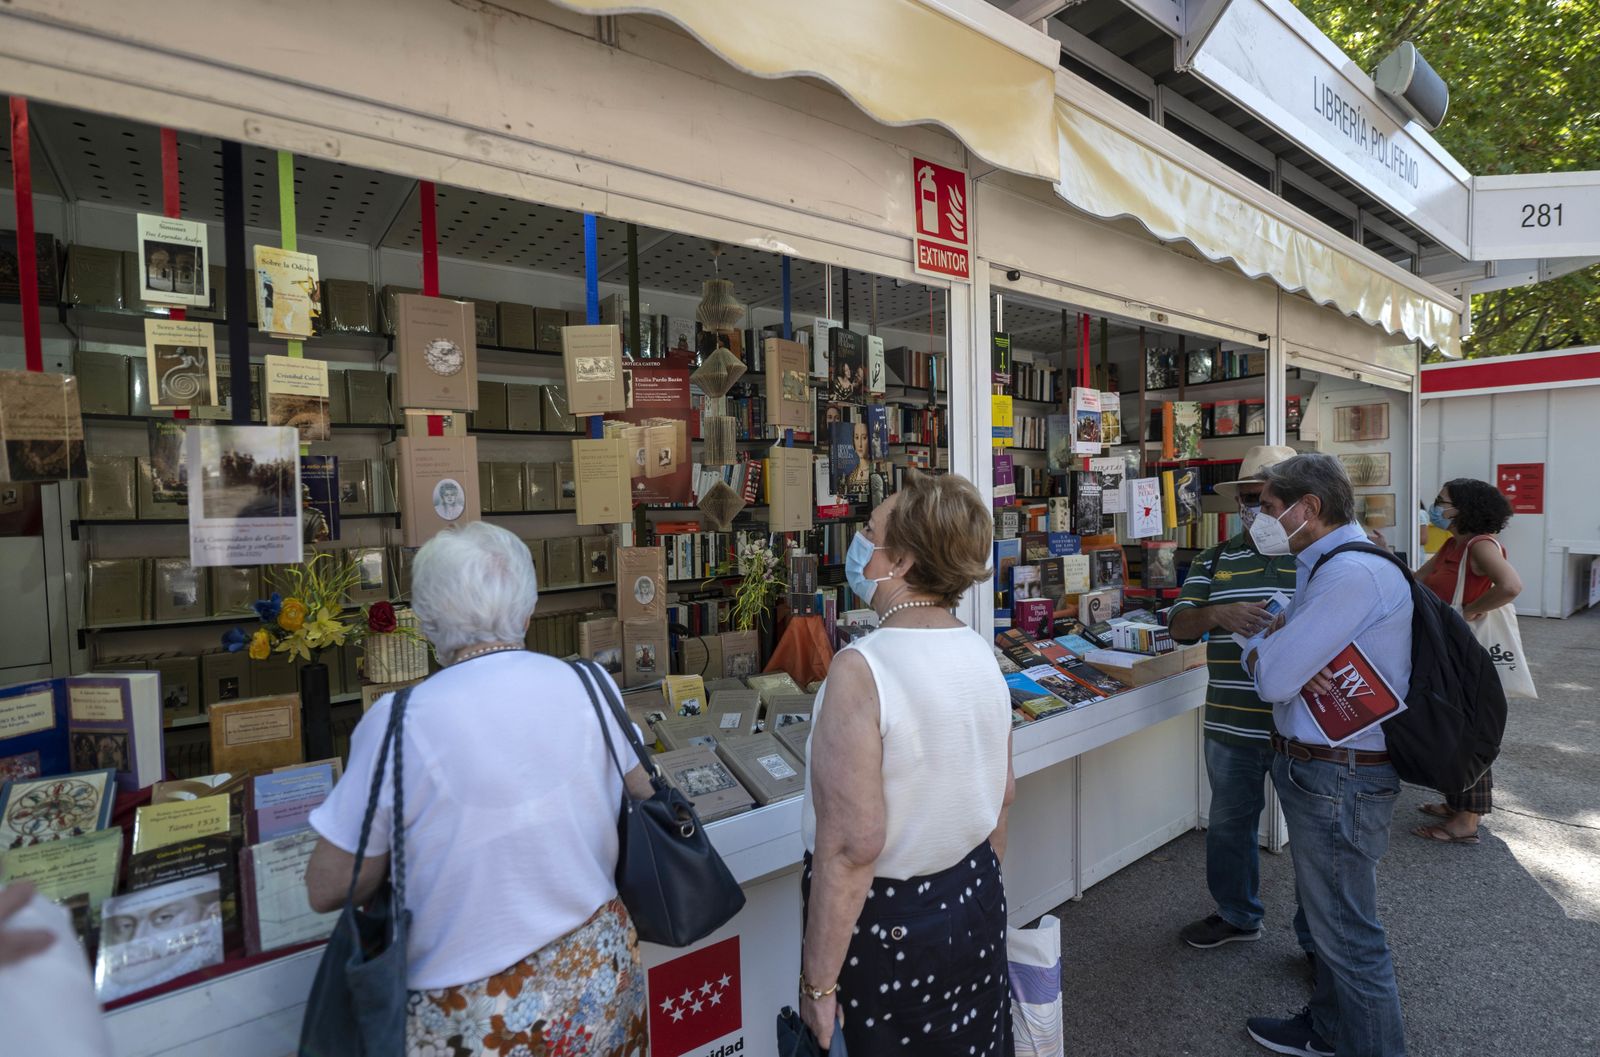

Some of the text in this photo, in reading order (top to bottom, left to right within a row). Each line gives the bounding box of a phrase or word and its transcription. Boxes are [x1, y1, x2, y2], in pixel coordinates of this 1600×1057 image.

[1313, 75, 1419, 190] LIBRERÍA POLIFEMO
[1521, 203, 1563, 228] 281
[261, 258, 281, 267] Sobre
[291, 263, 315, 273] Odisea
[920, 245, 967, 273] EXTINTOR
[197, 817, 221, 828] 1535
